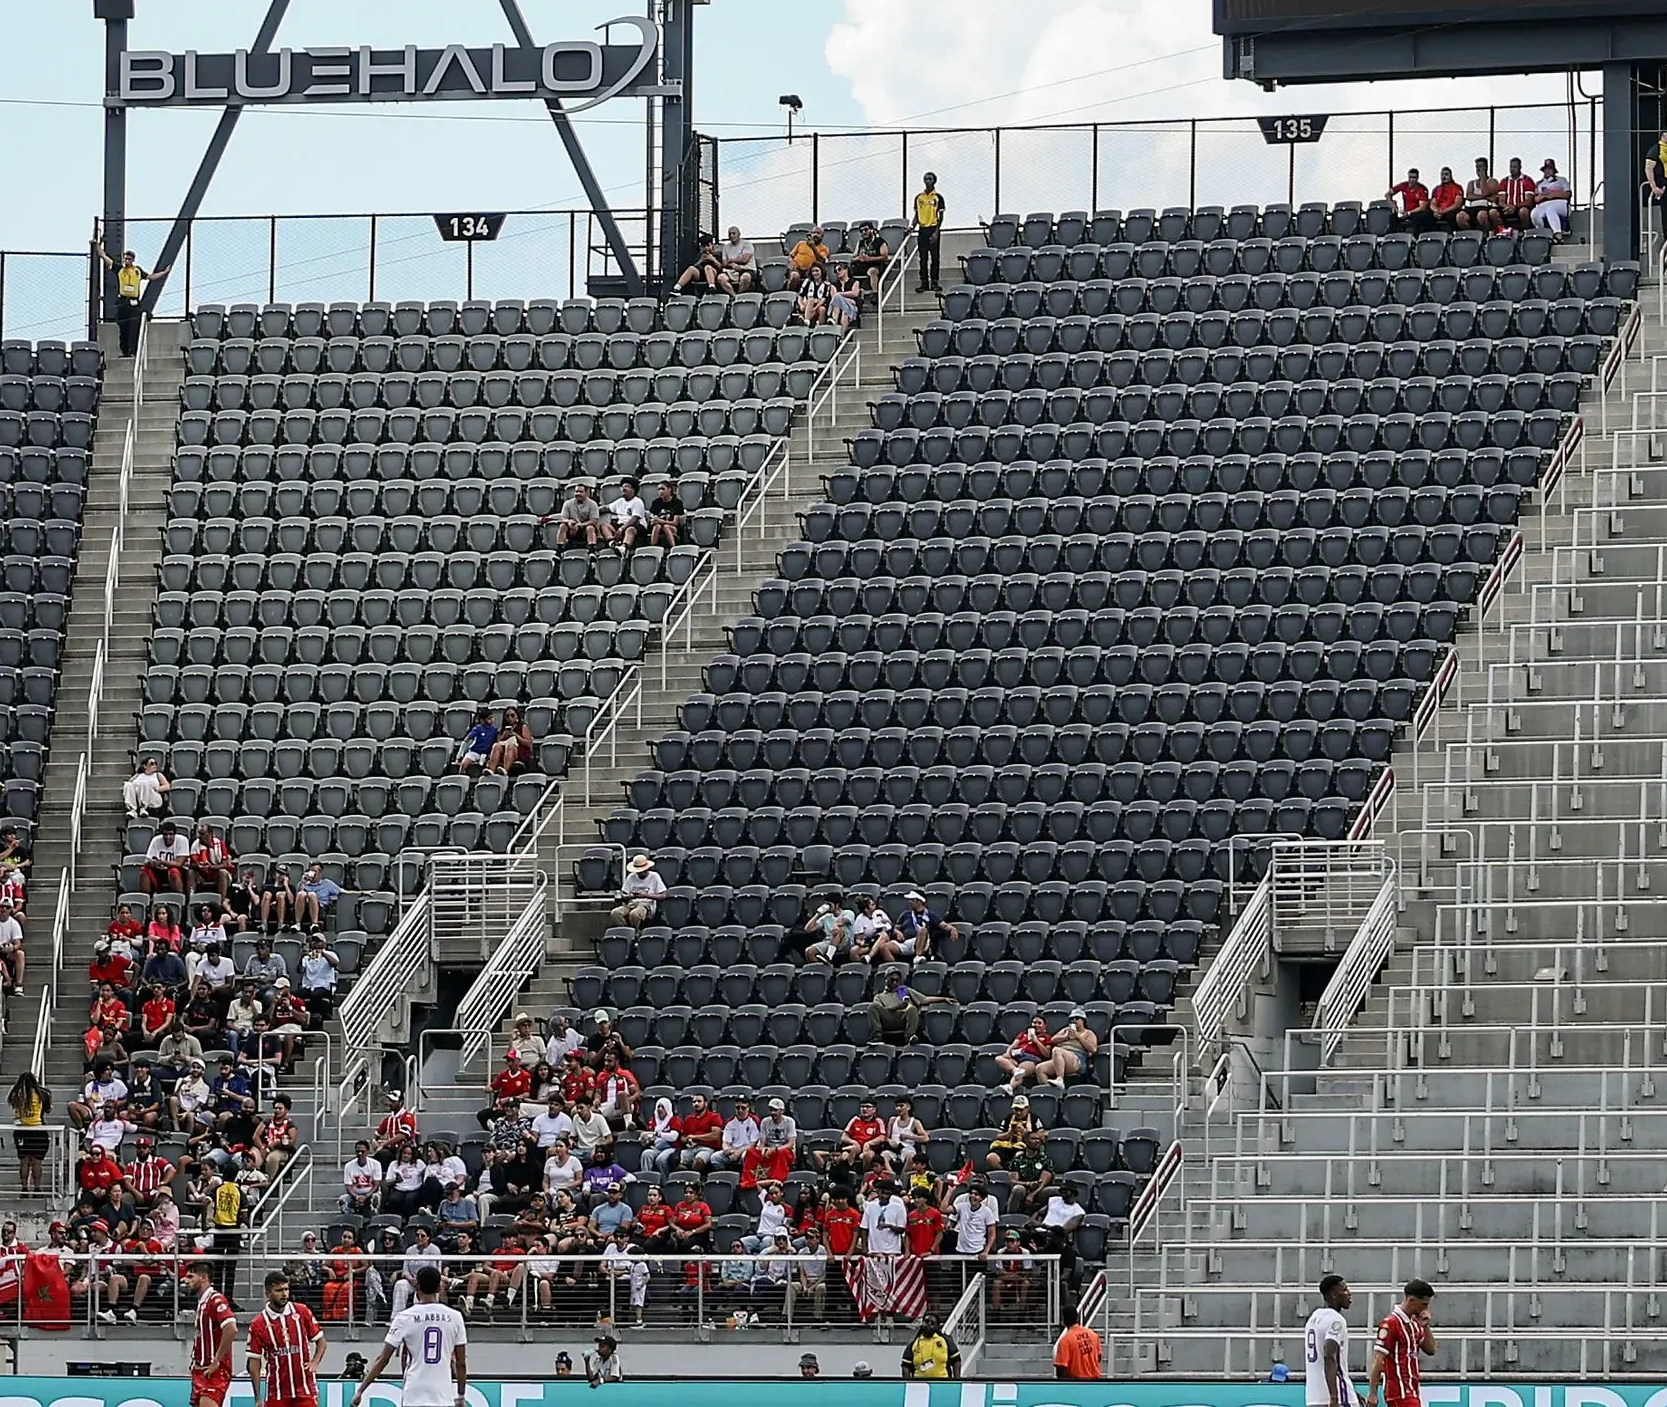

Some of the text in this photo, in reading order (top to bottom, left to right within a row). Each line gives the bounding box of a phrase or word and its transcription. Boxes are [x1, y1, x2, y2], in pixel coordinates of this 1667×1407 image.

[119, 40, 604, 101] BLUEHALO
[1273, 118, 1312, 140] 135
[449, 216, 489, 237] 134
[424, 1326, 442, 1364] 8
[1307, 1329, 1318, 1363] 9
